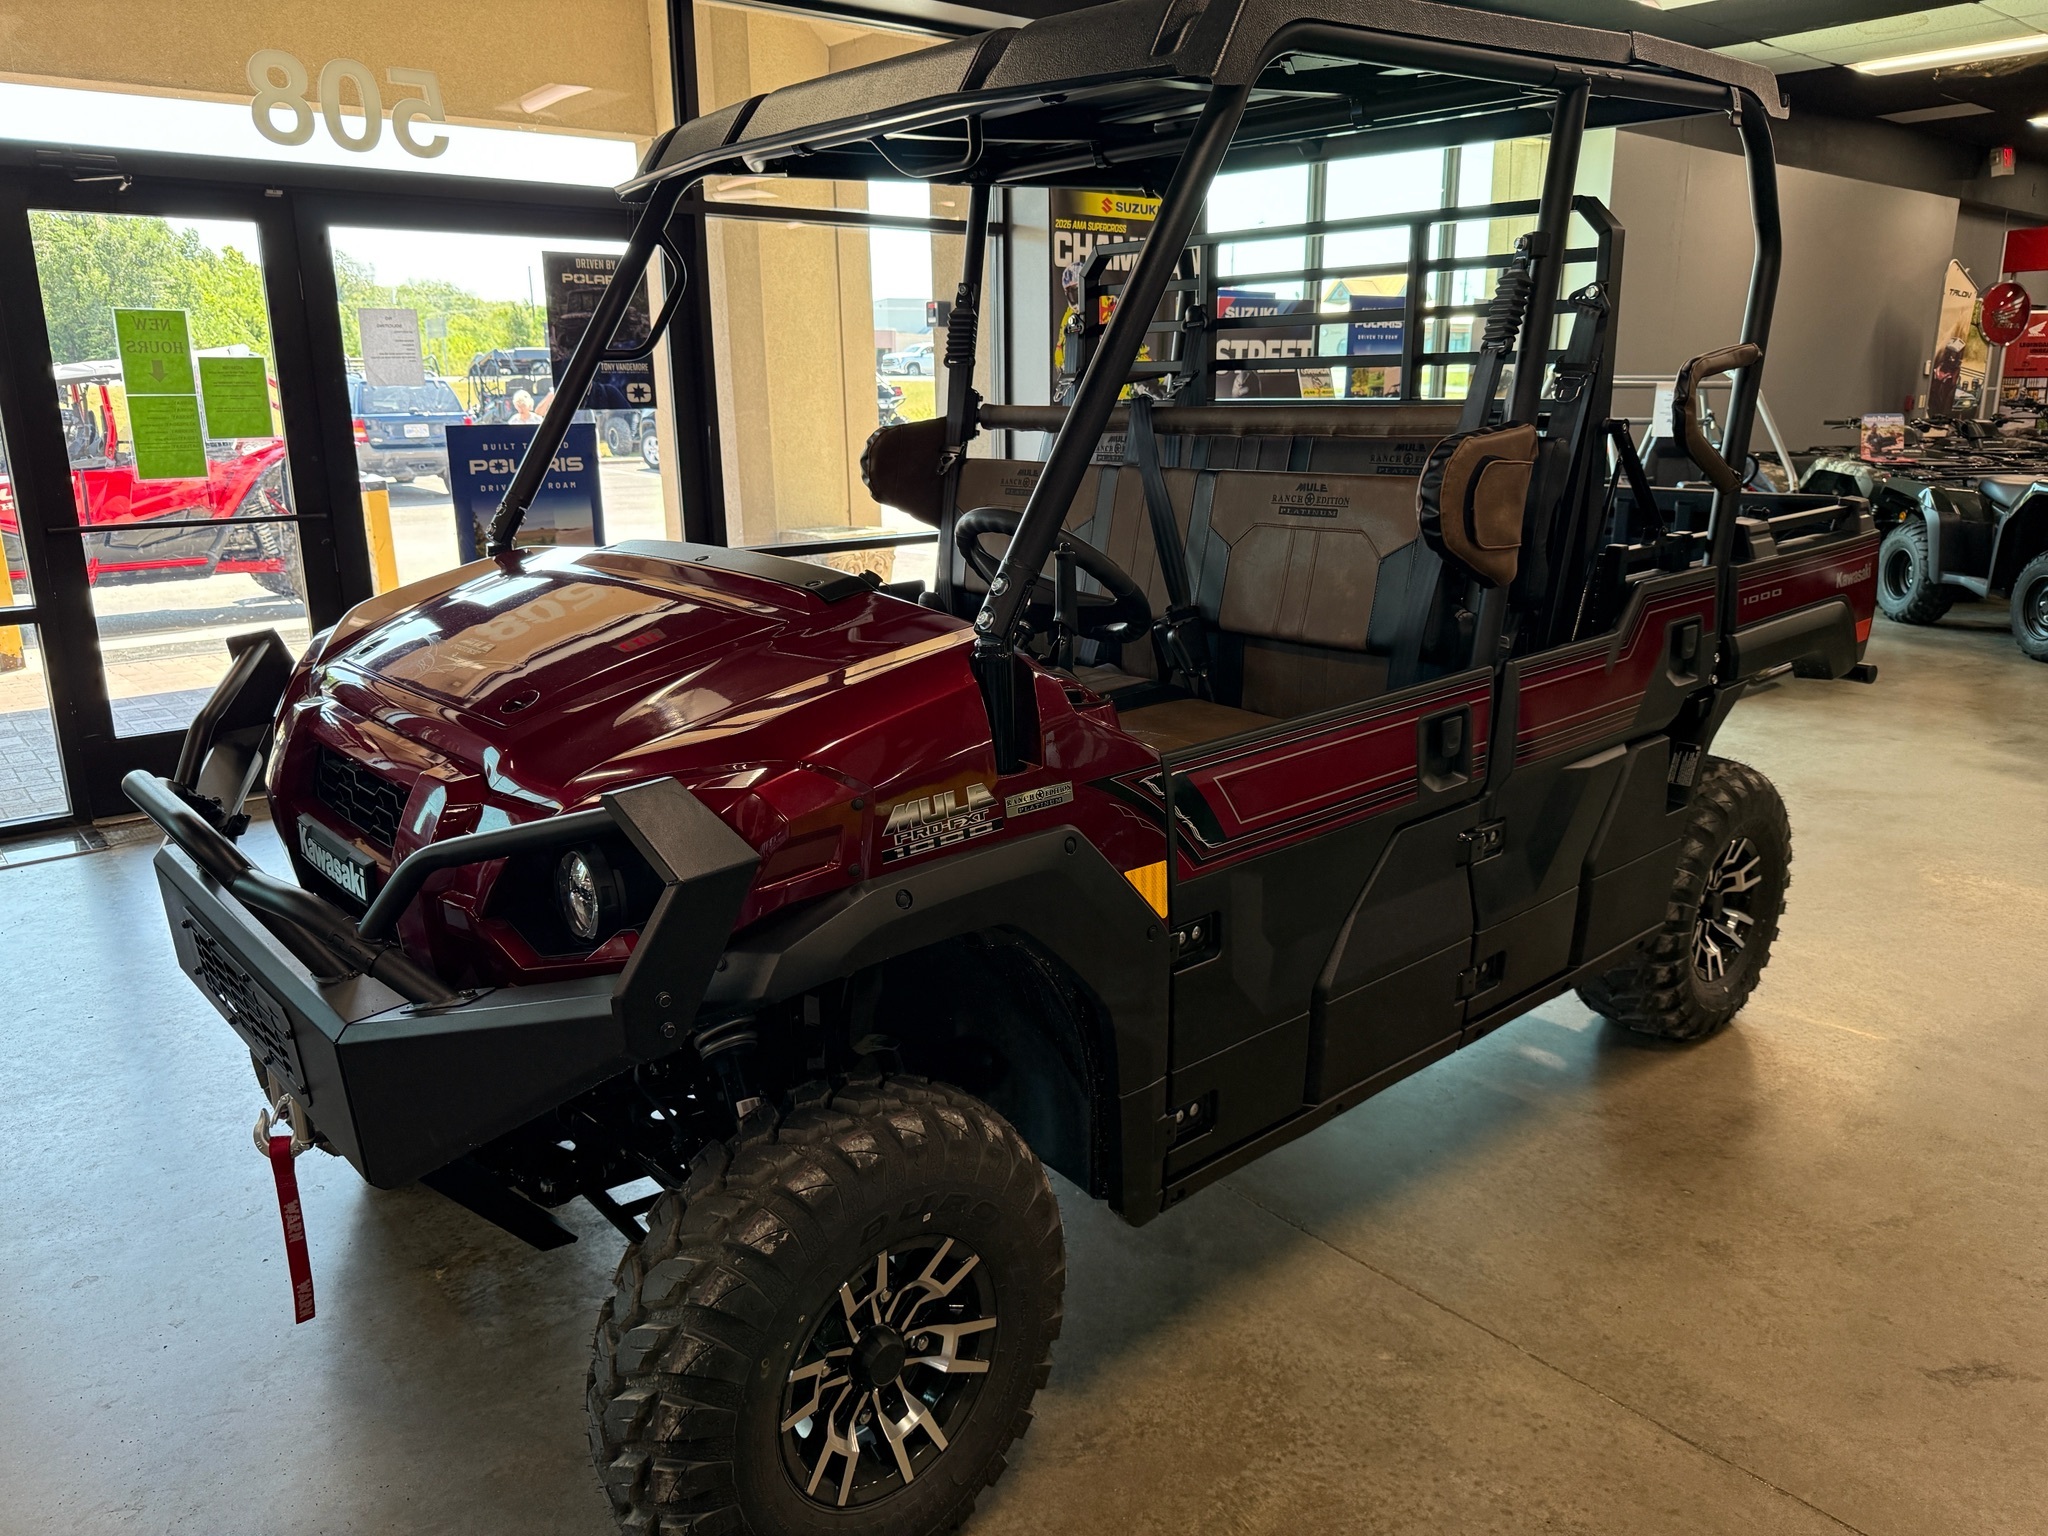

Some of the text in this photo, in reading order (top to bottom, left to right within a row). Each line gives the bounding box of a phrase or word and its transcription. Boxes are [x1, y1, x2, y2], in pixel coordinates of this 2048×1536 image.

[1115, 201, 1160, 215] SUZUK
[1055, 219, 1127, 233] 2026 AMA SUPERCROSS
[575, 258, 616, 270] DRIVEN BY
[601, 362, 649, 372] TONY VANDEMORE
[482, 443, 515, 451] BUILT
[469, 456, 584, 475] POLRIS
[480, 481, 576, 492] DRIV ROAM
[1295, 482, 1329, 493] MULE
[1271, 494, 1350, 505] RANCH EDITION
[1279, 507, 1338, 518] PLATINUM
[1836, 563, 1872, 588] Kawasaki
[1743, 588, 1782, 605] 1000
[1006, 793, 1035, 806] RANCH
[882, 782, 999, 837] MULE
[894, 821, 994, 860] 1000
[298, 822, 367, 901] Kawasaki
[284, 1200, 304, 1243] WARN
[297, 1279, 314, 1318] WARN
